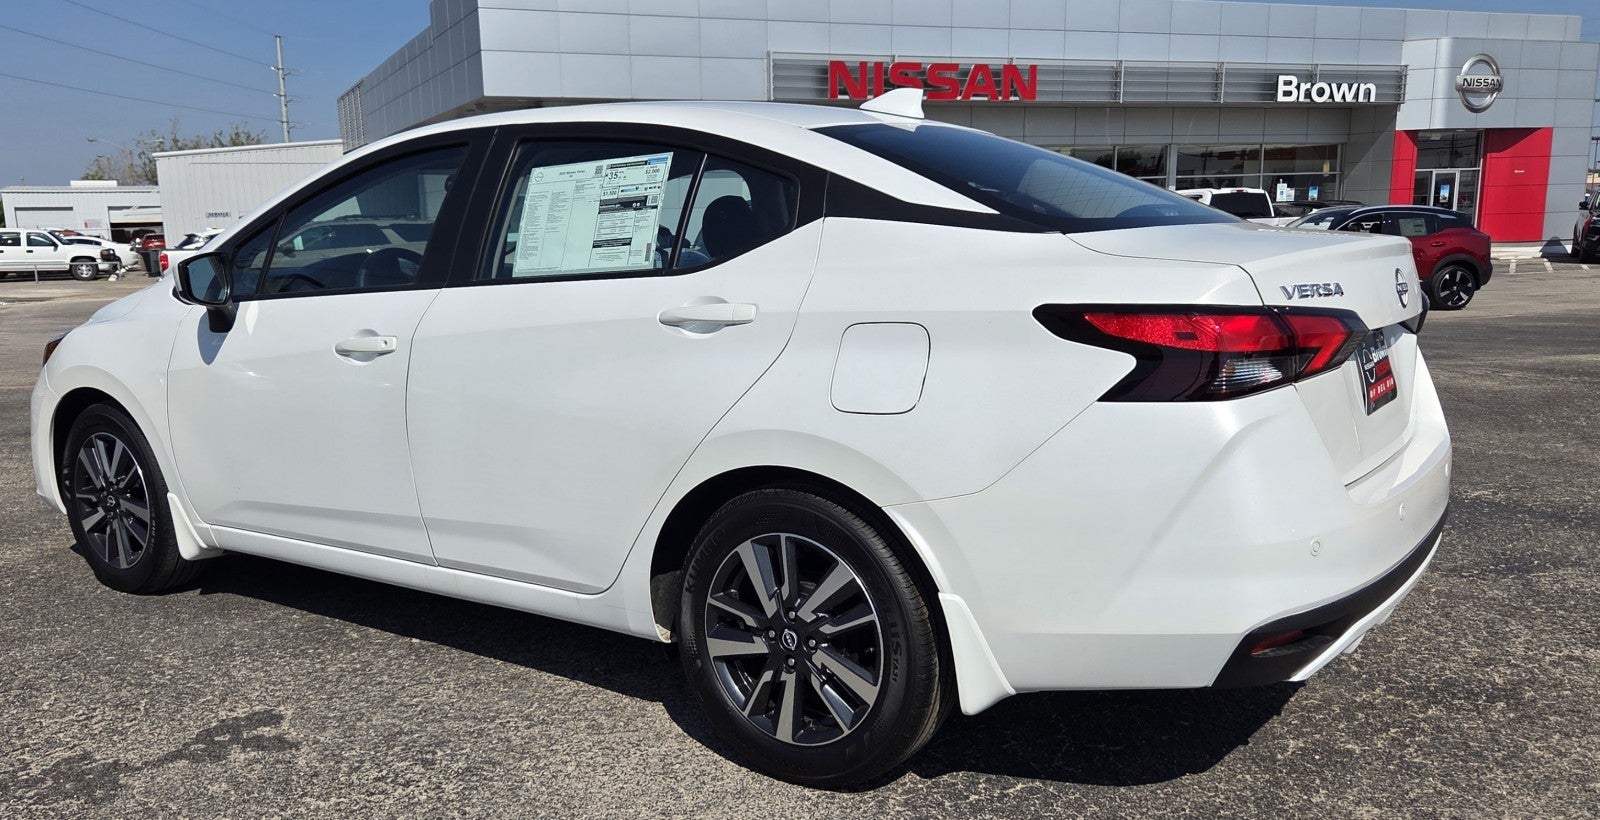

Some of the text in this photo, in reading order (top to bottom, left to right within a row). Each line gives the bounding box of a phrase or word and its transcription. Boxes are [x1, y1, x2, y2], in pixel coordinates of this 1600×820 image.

[828, 60, 1038, 101] NISSAN
[1277, 75, 1376, 102] Brown
[1462, 77, 1501, 88] NISSAN
[608, 171, 618, 180] 35
[1280, 283, 1344, 300] VERSA
